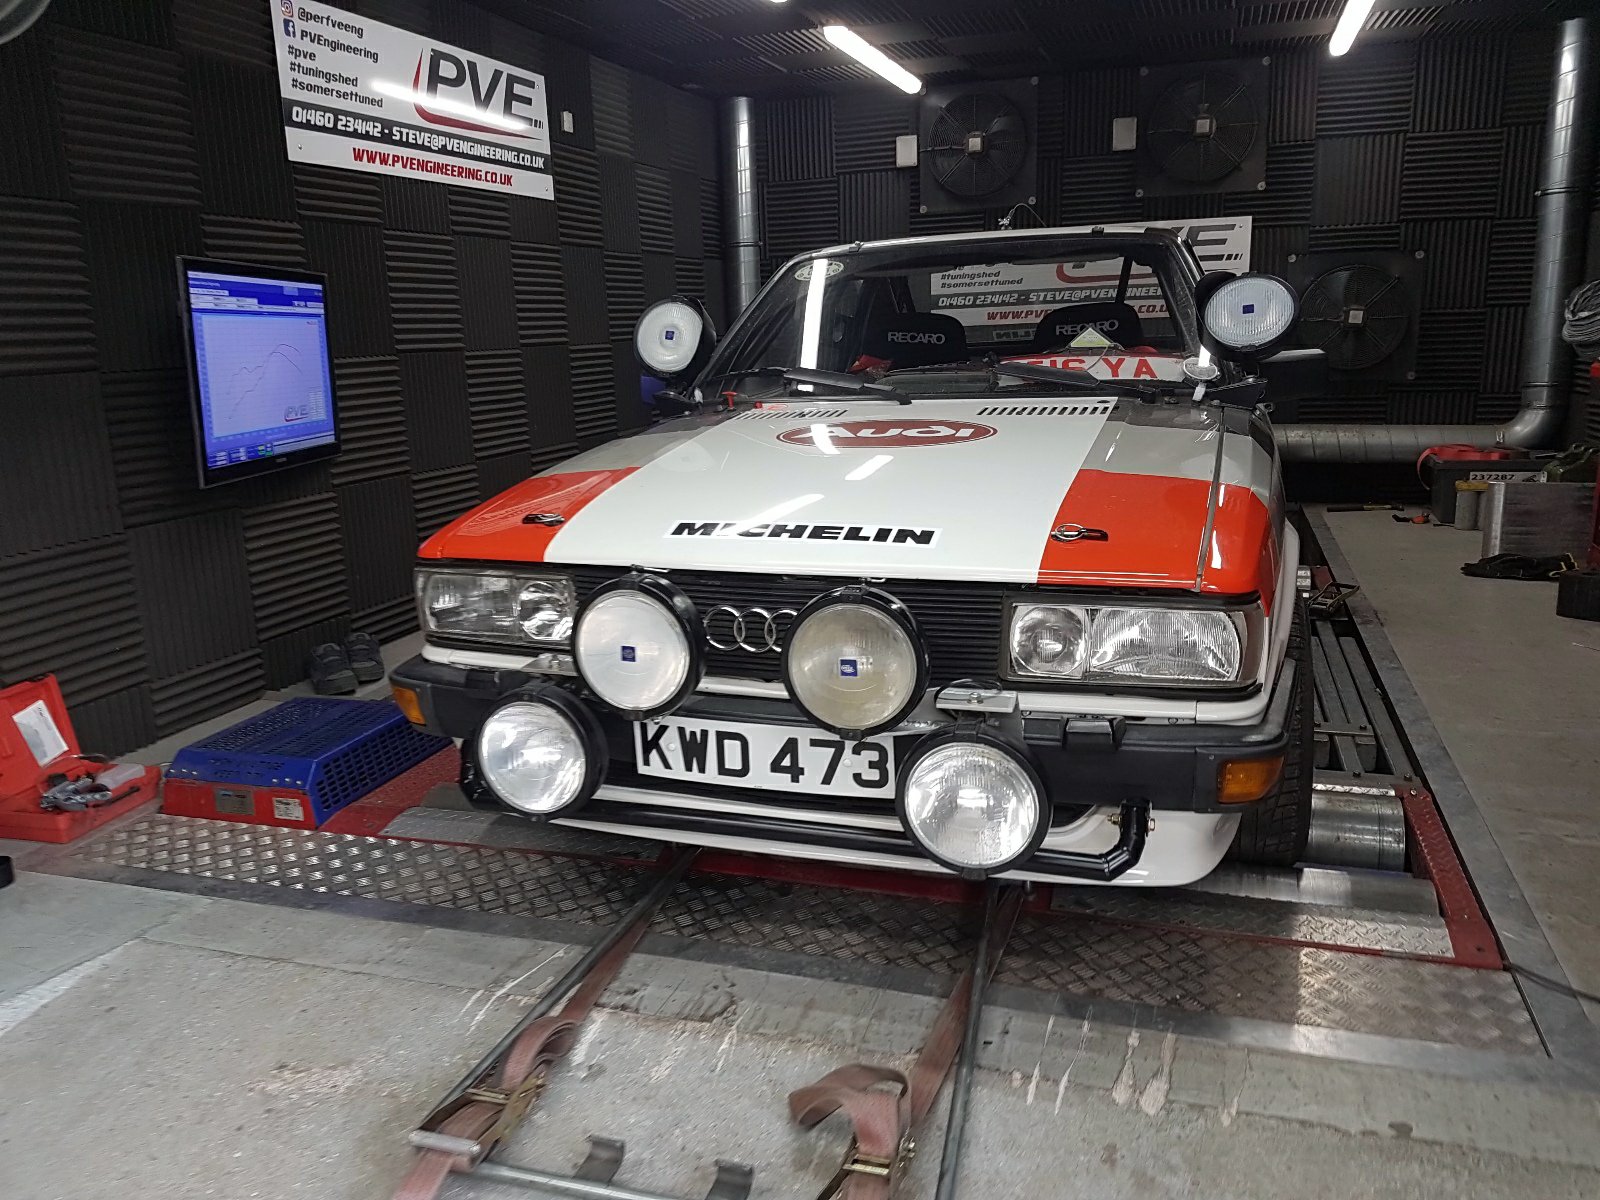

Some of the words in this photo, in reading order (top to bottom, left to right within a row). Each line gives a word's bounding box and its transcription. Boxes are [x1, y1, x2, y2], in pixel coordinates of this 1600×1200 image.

[298, 7, 364, 38] @perfveeng
[288, 45, 316, 62] #pve
[300, 29, 379, 63] PVEngineering
[290, 61, 358, 88] #tuningshed
[427, 48, 541, 128] PVE
[291, 78, 383, 108] #somersettuned
[292, 106, 334, 128] 01460
[338, 115, 381, 137] 234142
[392, 126, 544, 169] STEVE@PVENGINEERING.CO.UK
[353, 147, 513, 186] WWW.PVENGINEERING.CO.UK
[941, 271, 1000, 280] #tuningshed
[941, 278, 1023, 288] #somersettuned
[938, 296, 974, 306] 01460
[888, 332, 946, 344] RECARO
[641, 721, 750, 779] KWD
[770, 737, 889, 790] 473
